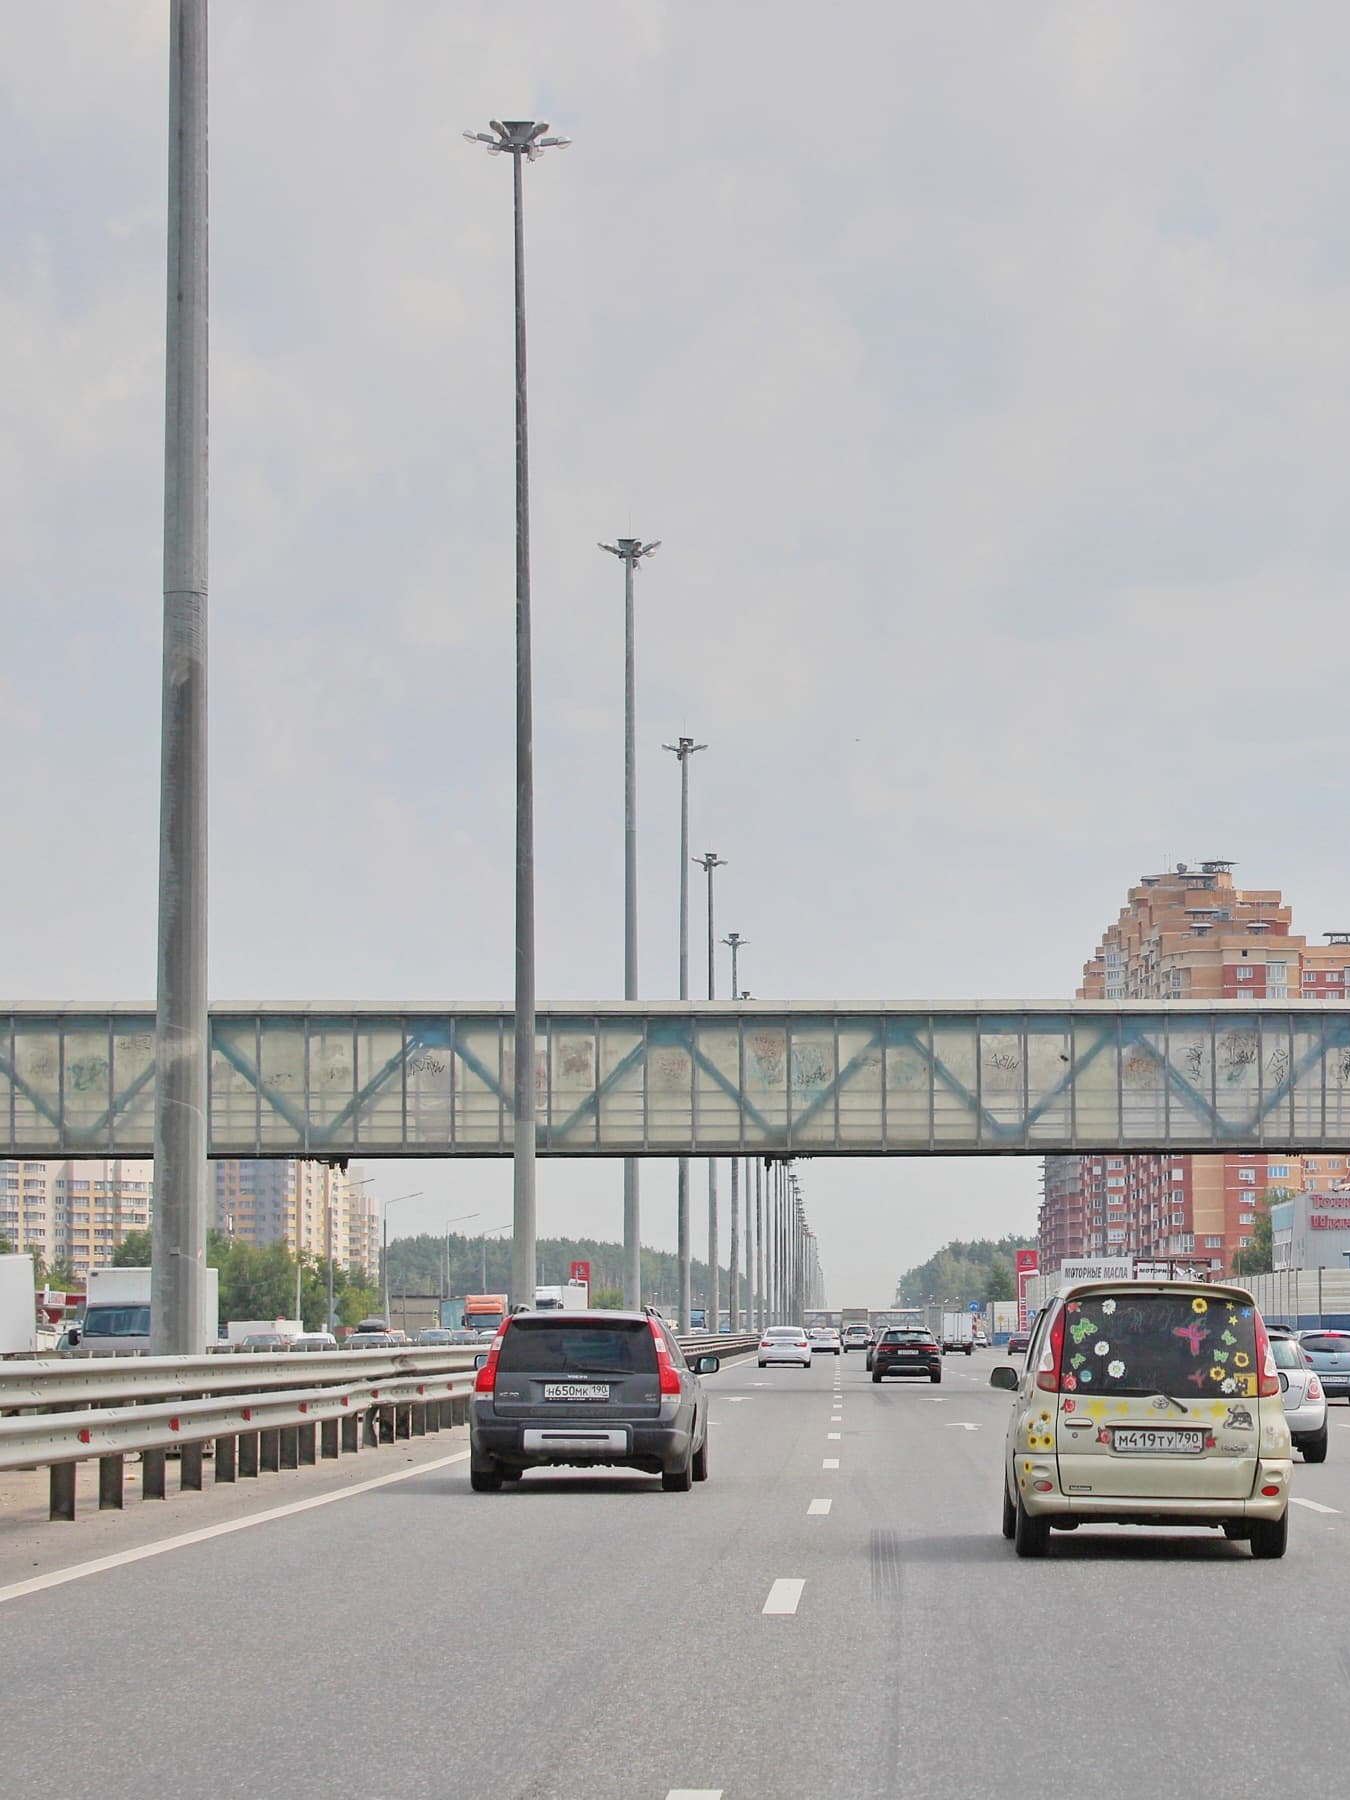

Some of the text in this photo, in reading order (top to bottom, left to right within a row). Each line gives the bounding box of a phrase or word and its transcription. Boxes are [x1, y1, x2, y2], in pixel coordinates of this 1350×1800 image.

[1064, 1266, 1128, 1279] МОТОРНЫЕ МАСЛА
[592, 1385, 607, 1394] 190
[1178, 1432, 1199, 1444] 790
